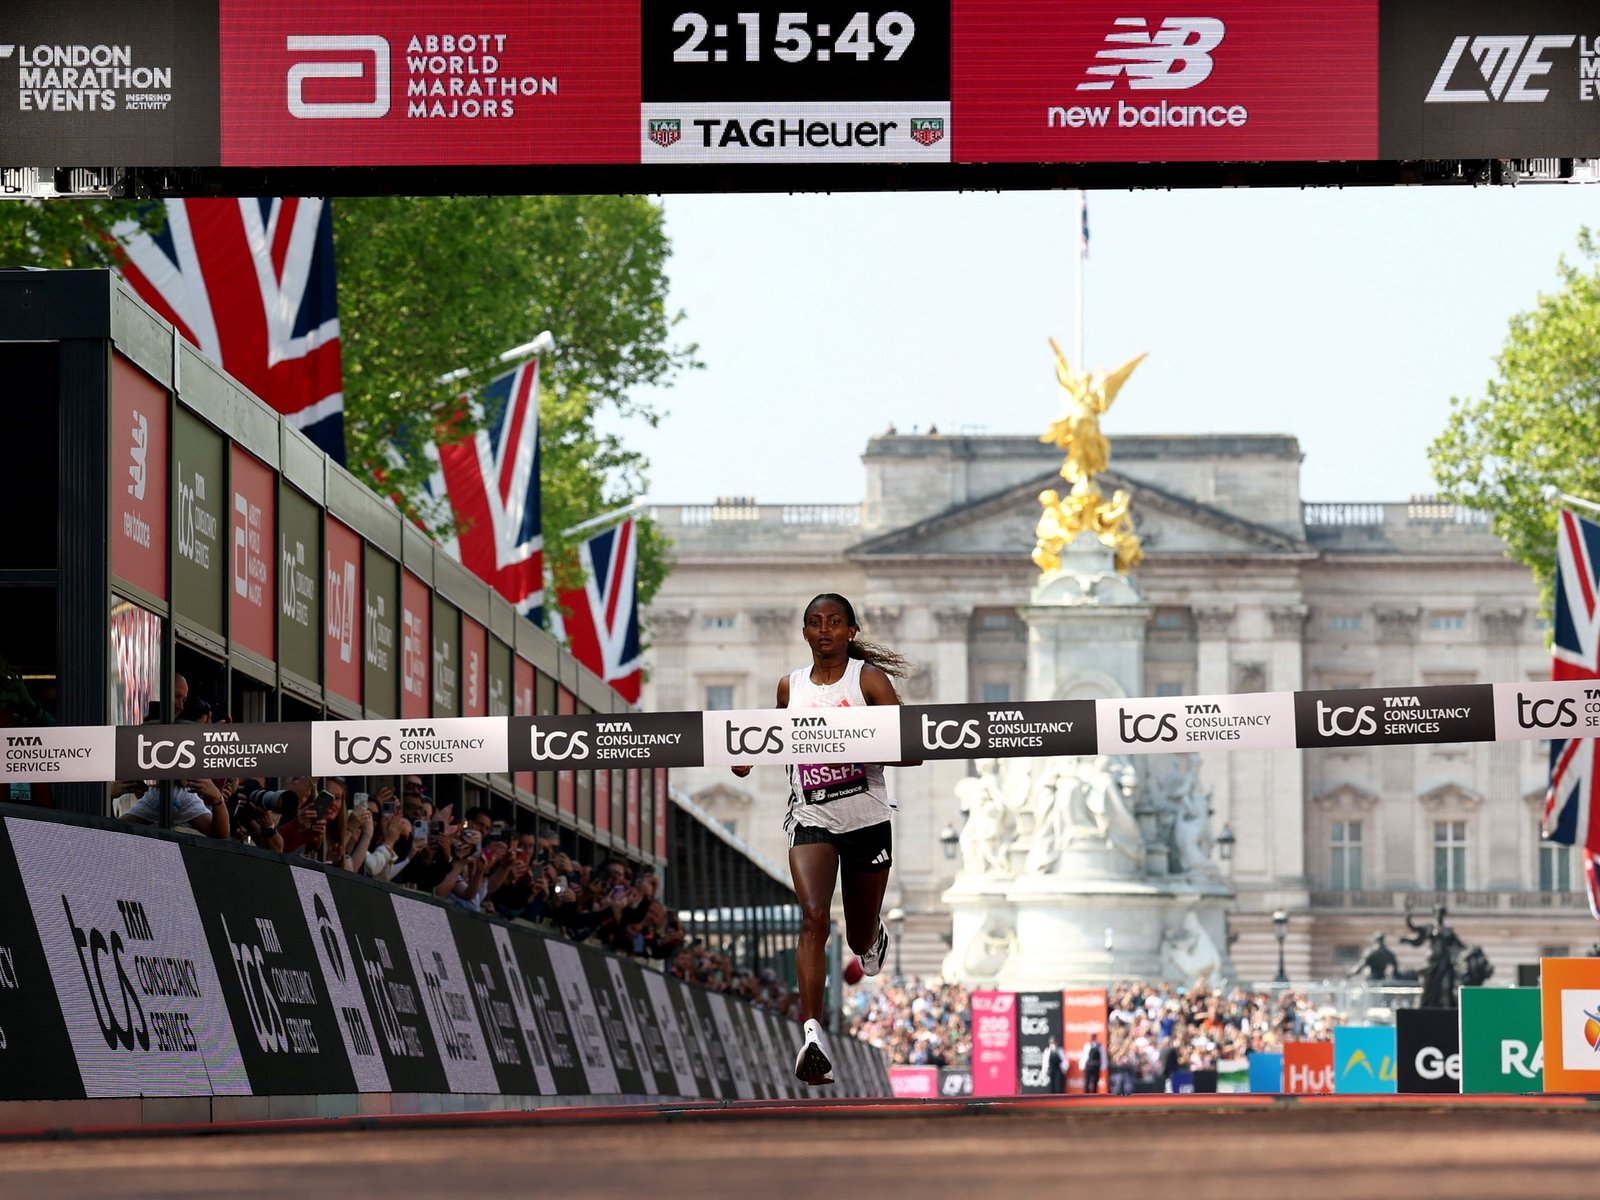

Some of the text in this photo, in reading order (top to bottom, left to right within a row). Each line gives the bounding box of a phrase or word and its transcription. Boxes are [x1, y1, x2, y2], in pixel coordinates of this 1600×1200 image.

[407, 34, 508, 53] ABBOTT
[672, 11, 915, 63] 2:15:49
[19, 45, 131, 66] LONDON
[407, 56, 499, 74] WORLD
[19, 67, 171, 88] MARATHON
[407, 77, 558, 96] MARATHON
[19, 89, 116, 111] EVENTS
[125, 93, 171, 102] INSPIRING
[125, 102, 168, 110] ACTIVITY
[407, 99, 515, 118] MAJORS
[1047, 100, 1248, 128] new balance
[178, 461, 194, 559] tcs
[1382, 696, 1420, 707] TATA
[987, 710, 1025, 721] TATA
[1185, 704, 1221, 714] TATA
[1383, 707, 1470, 720] CONSULTANCY
[1517, 692, 1577, 728] tcs
[791, 717, 827, 727] TATA
[1119, 707, 1178, 743] tcs
[1185, 715, 1271, 728] CONSULTANCY
[1317, 700, 1377, 737] tcs
[400, 727, 435, 737] TATA
[596, 722, 633, 732] TATA
[921, 713, 981, 750] tcs
[987, 722, 1074, 735] CONSULTANCY
[1384, 722, 1440, 734] SERVICES
[203, 732, 240, 742] TATA
[596, 733, 681, 746] CONSULTANCY
[726, 719, 784, 755] tcs
[791, 728, 876, 741] CONSULTANCY
[1185, 730, 1241, 741] SERVICES
[6, 737, 43, 746] TATA
[334, 729, 393, 765] tcs
[399, 739, 485, 751] CONSULTANCY
[530, 724, 590, 761] tcs
[791, 742, 846, 754] SERVICES
[988, 736, 1043, 748] SERVICES
[6, 747, 92, 760] CONSULTANCY
[137, 733, 196, 770] tcs
[203, 743, 289, 756] CONSULTANCY
[596, 748, 651, 759] SERVICES
[203, 757, 257, 768] SERVICES
[399, 752, 454, 764] SERVICES
[5, 761, 60, 773] SERVICES
[803, 764, 862, 786] ASSEFA
[840, 785, 862, 797] balance
[117, 900, 154, 940] TATA
[62, 895, 149, 1051] tcs
[135, 955, 201, 998] CONSULTANCY
[220, 912, 289, 1053] tcs
[150, 1012, 197, 1051] SERVICES
